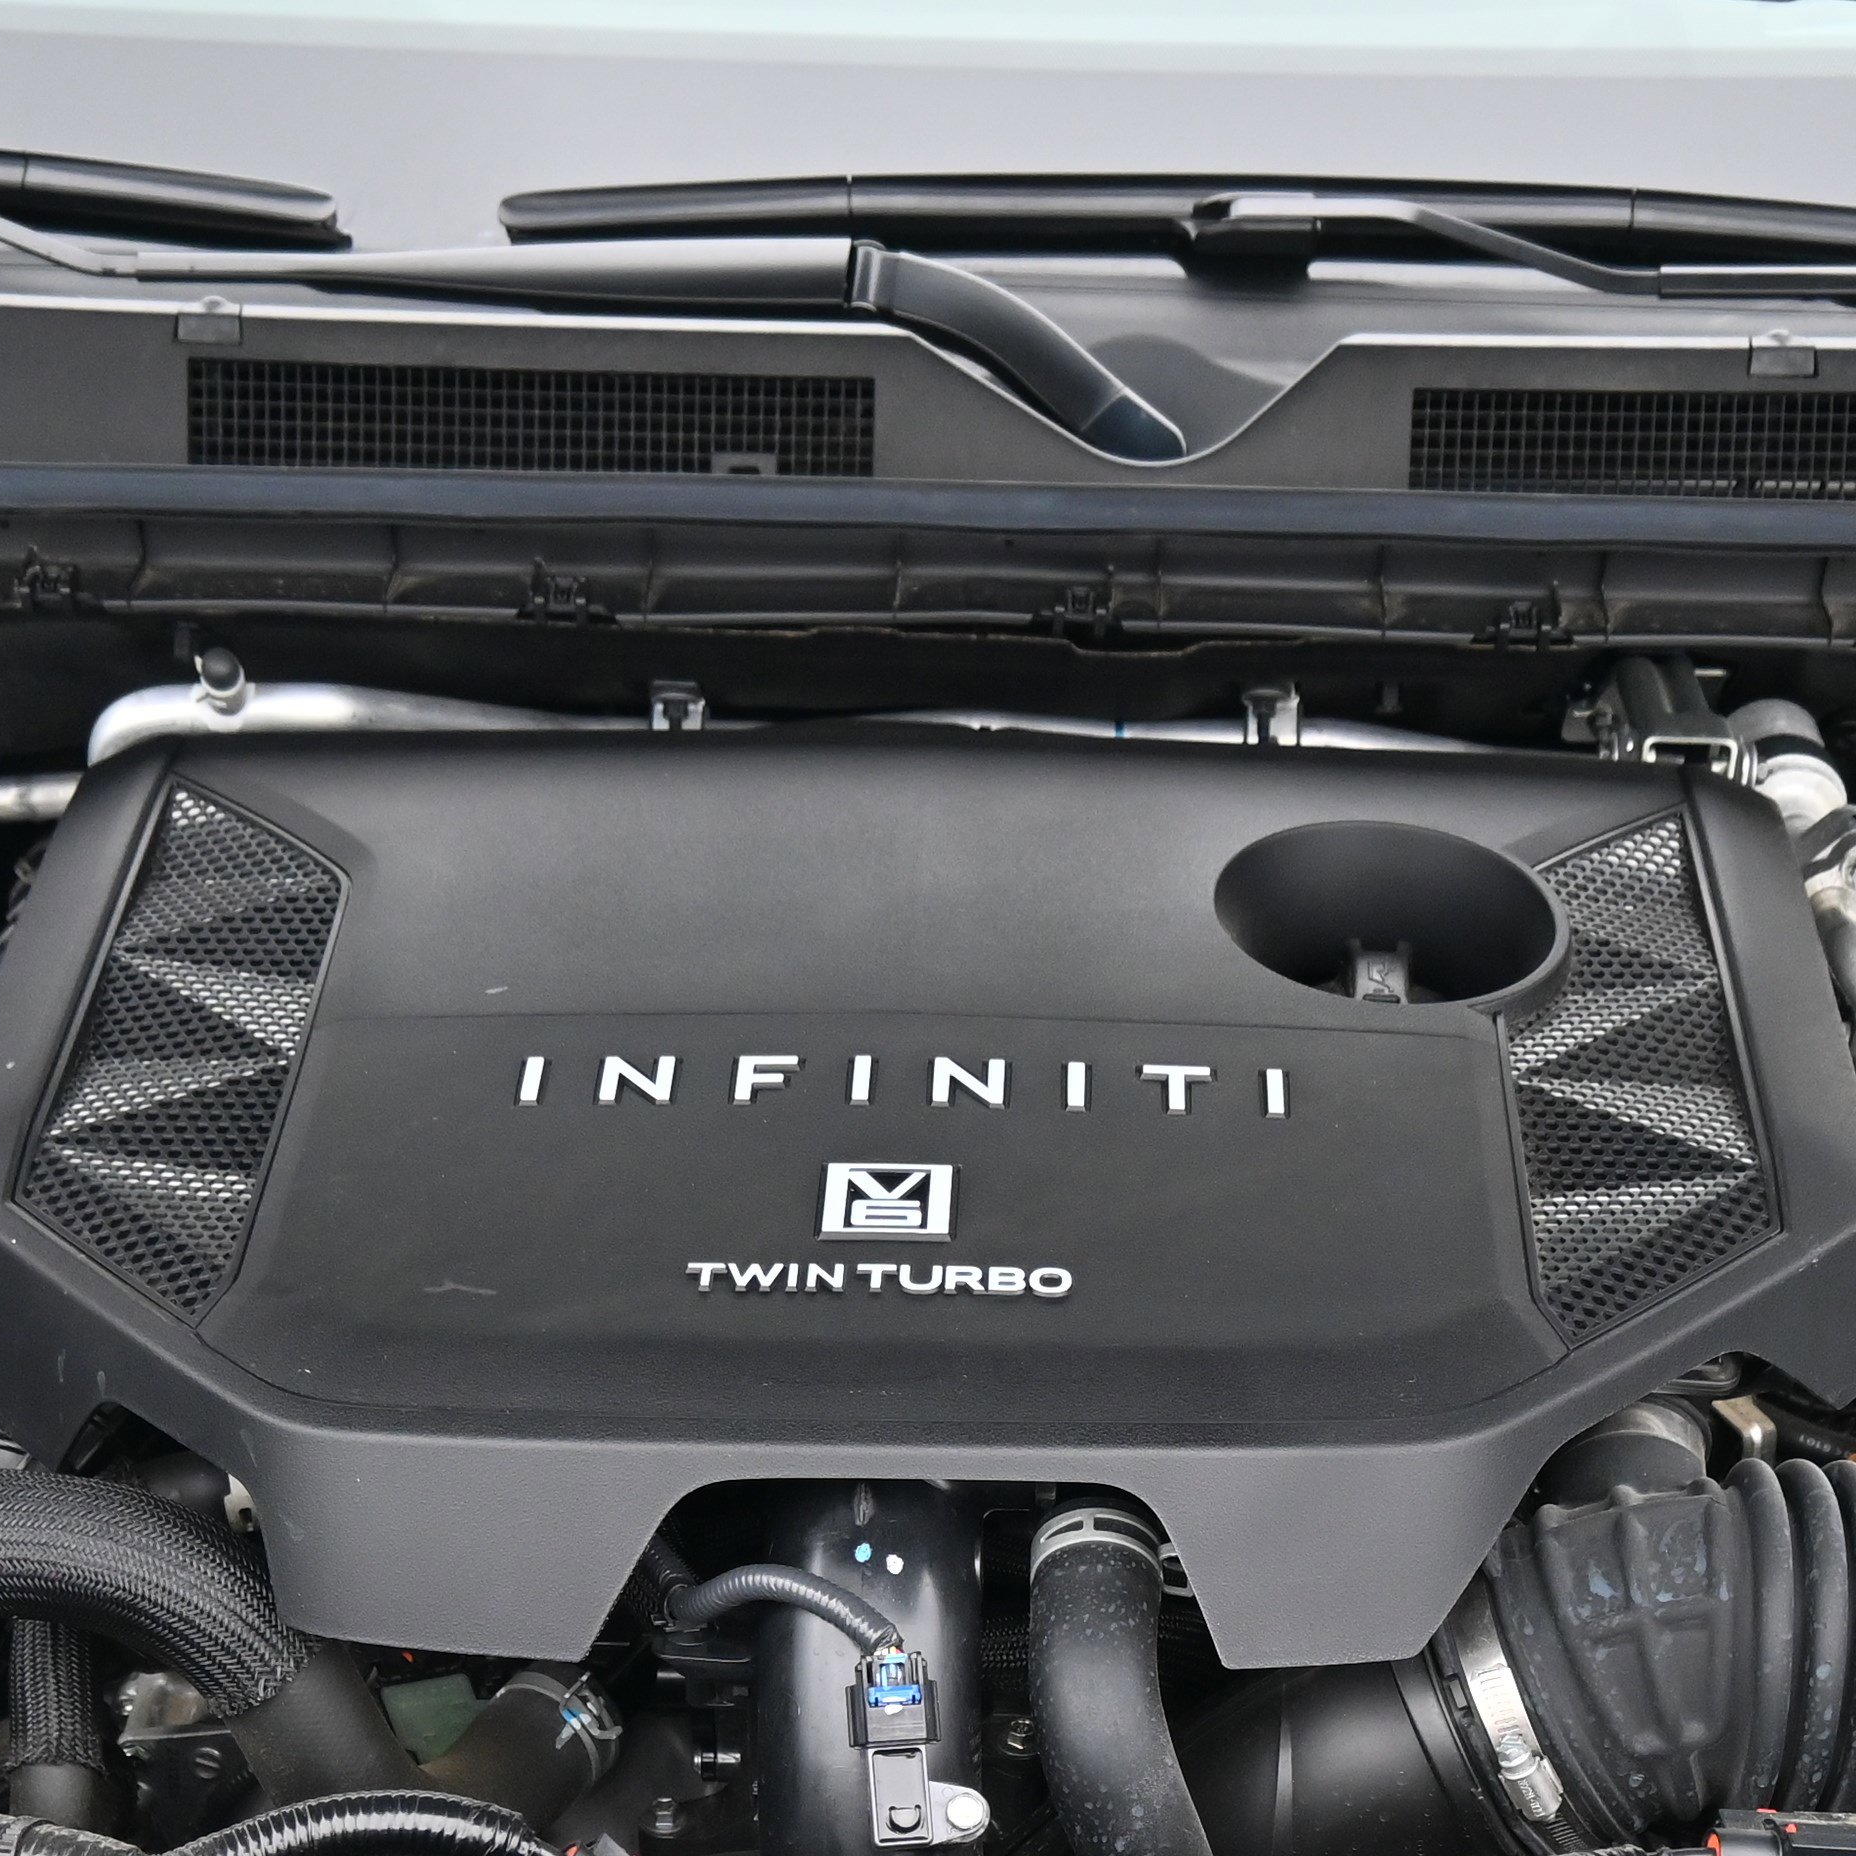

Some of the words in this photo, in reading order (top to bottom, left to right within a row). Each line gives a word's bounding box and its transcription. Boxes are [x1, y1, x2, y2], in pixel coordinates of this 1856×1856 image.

[514, 1055, 1291, 1119] INFINITI
[685, 1262, 845, 1293] TWIN
[855, 1263, 1073, 1297] TURBO
